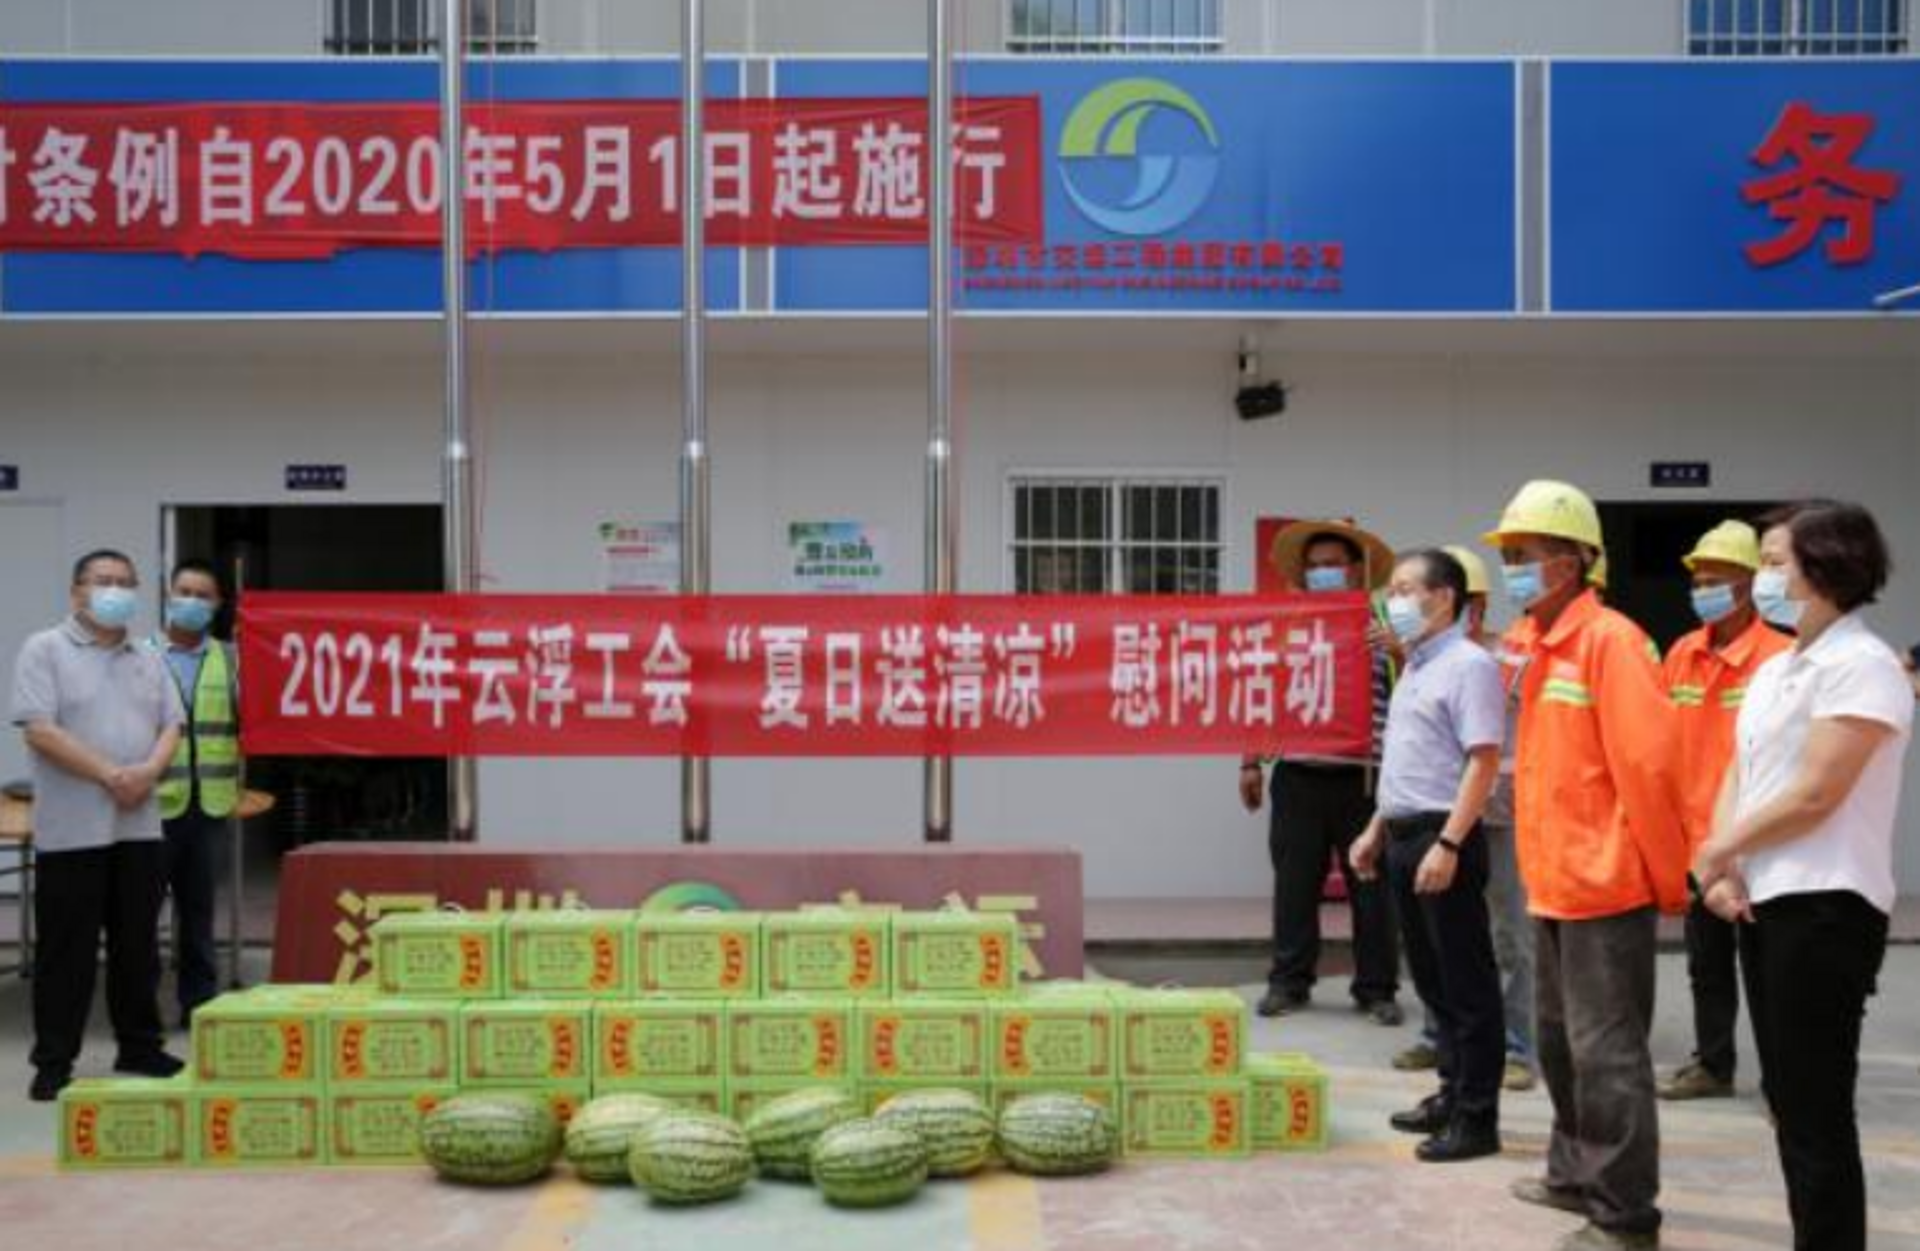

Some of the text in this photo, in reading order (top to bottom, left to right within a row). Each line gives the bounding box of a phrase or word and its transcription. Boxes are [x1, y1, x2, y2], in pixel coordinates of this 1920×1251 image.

[0, 122, 1006, 227] 条例自2020年5月1日起施行
[1742, 99, 1899, 267] 务
